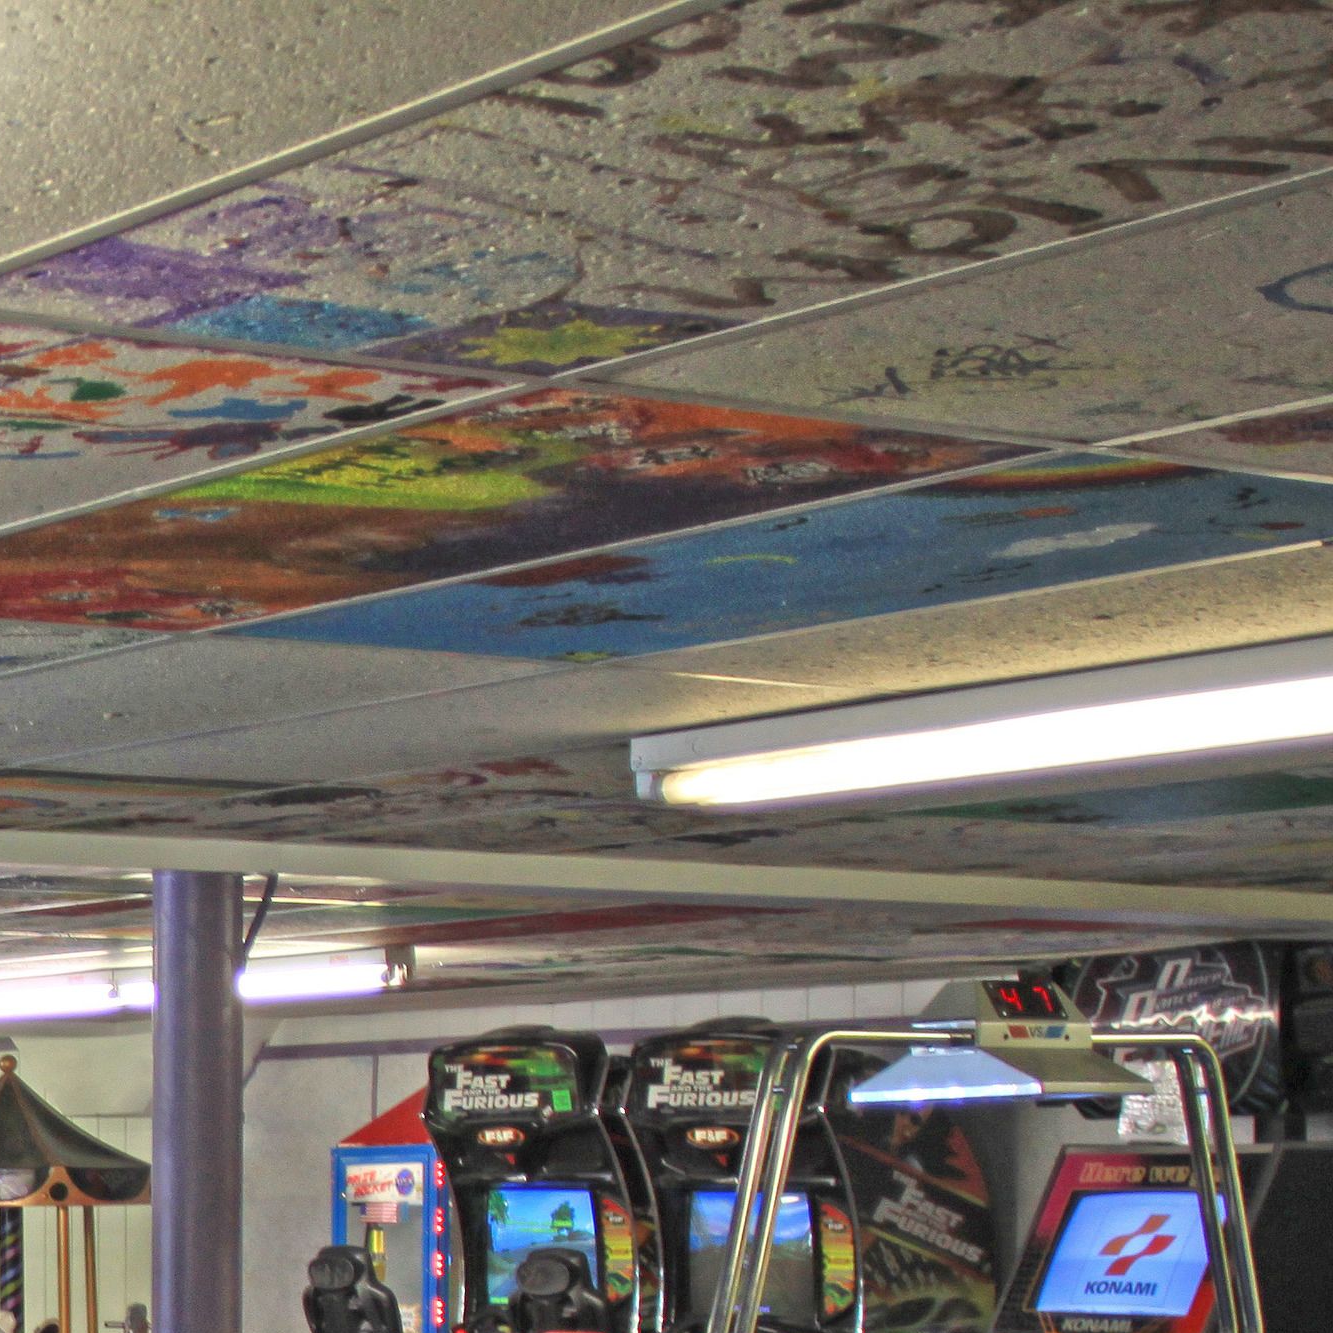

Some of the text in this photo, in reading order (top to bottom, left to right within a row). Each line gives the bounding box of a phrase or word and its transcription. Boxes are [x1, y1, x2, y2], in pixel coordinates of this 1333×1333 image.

[456, 1070, 511, 1089] FAST
[663, 1065, 724, 1085] FAST
[444, 1089, 539, 1112] FURIOUS
[647, 1085, 756, 1109] FURIOUS
[1084, 1280, 1158, 1297] KONAMI
[1062, 1318, 1132, 1333] KONAMI
